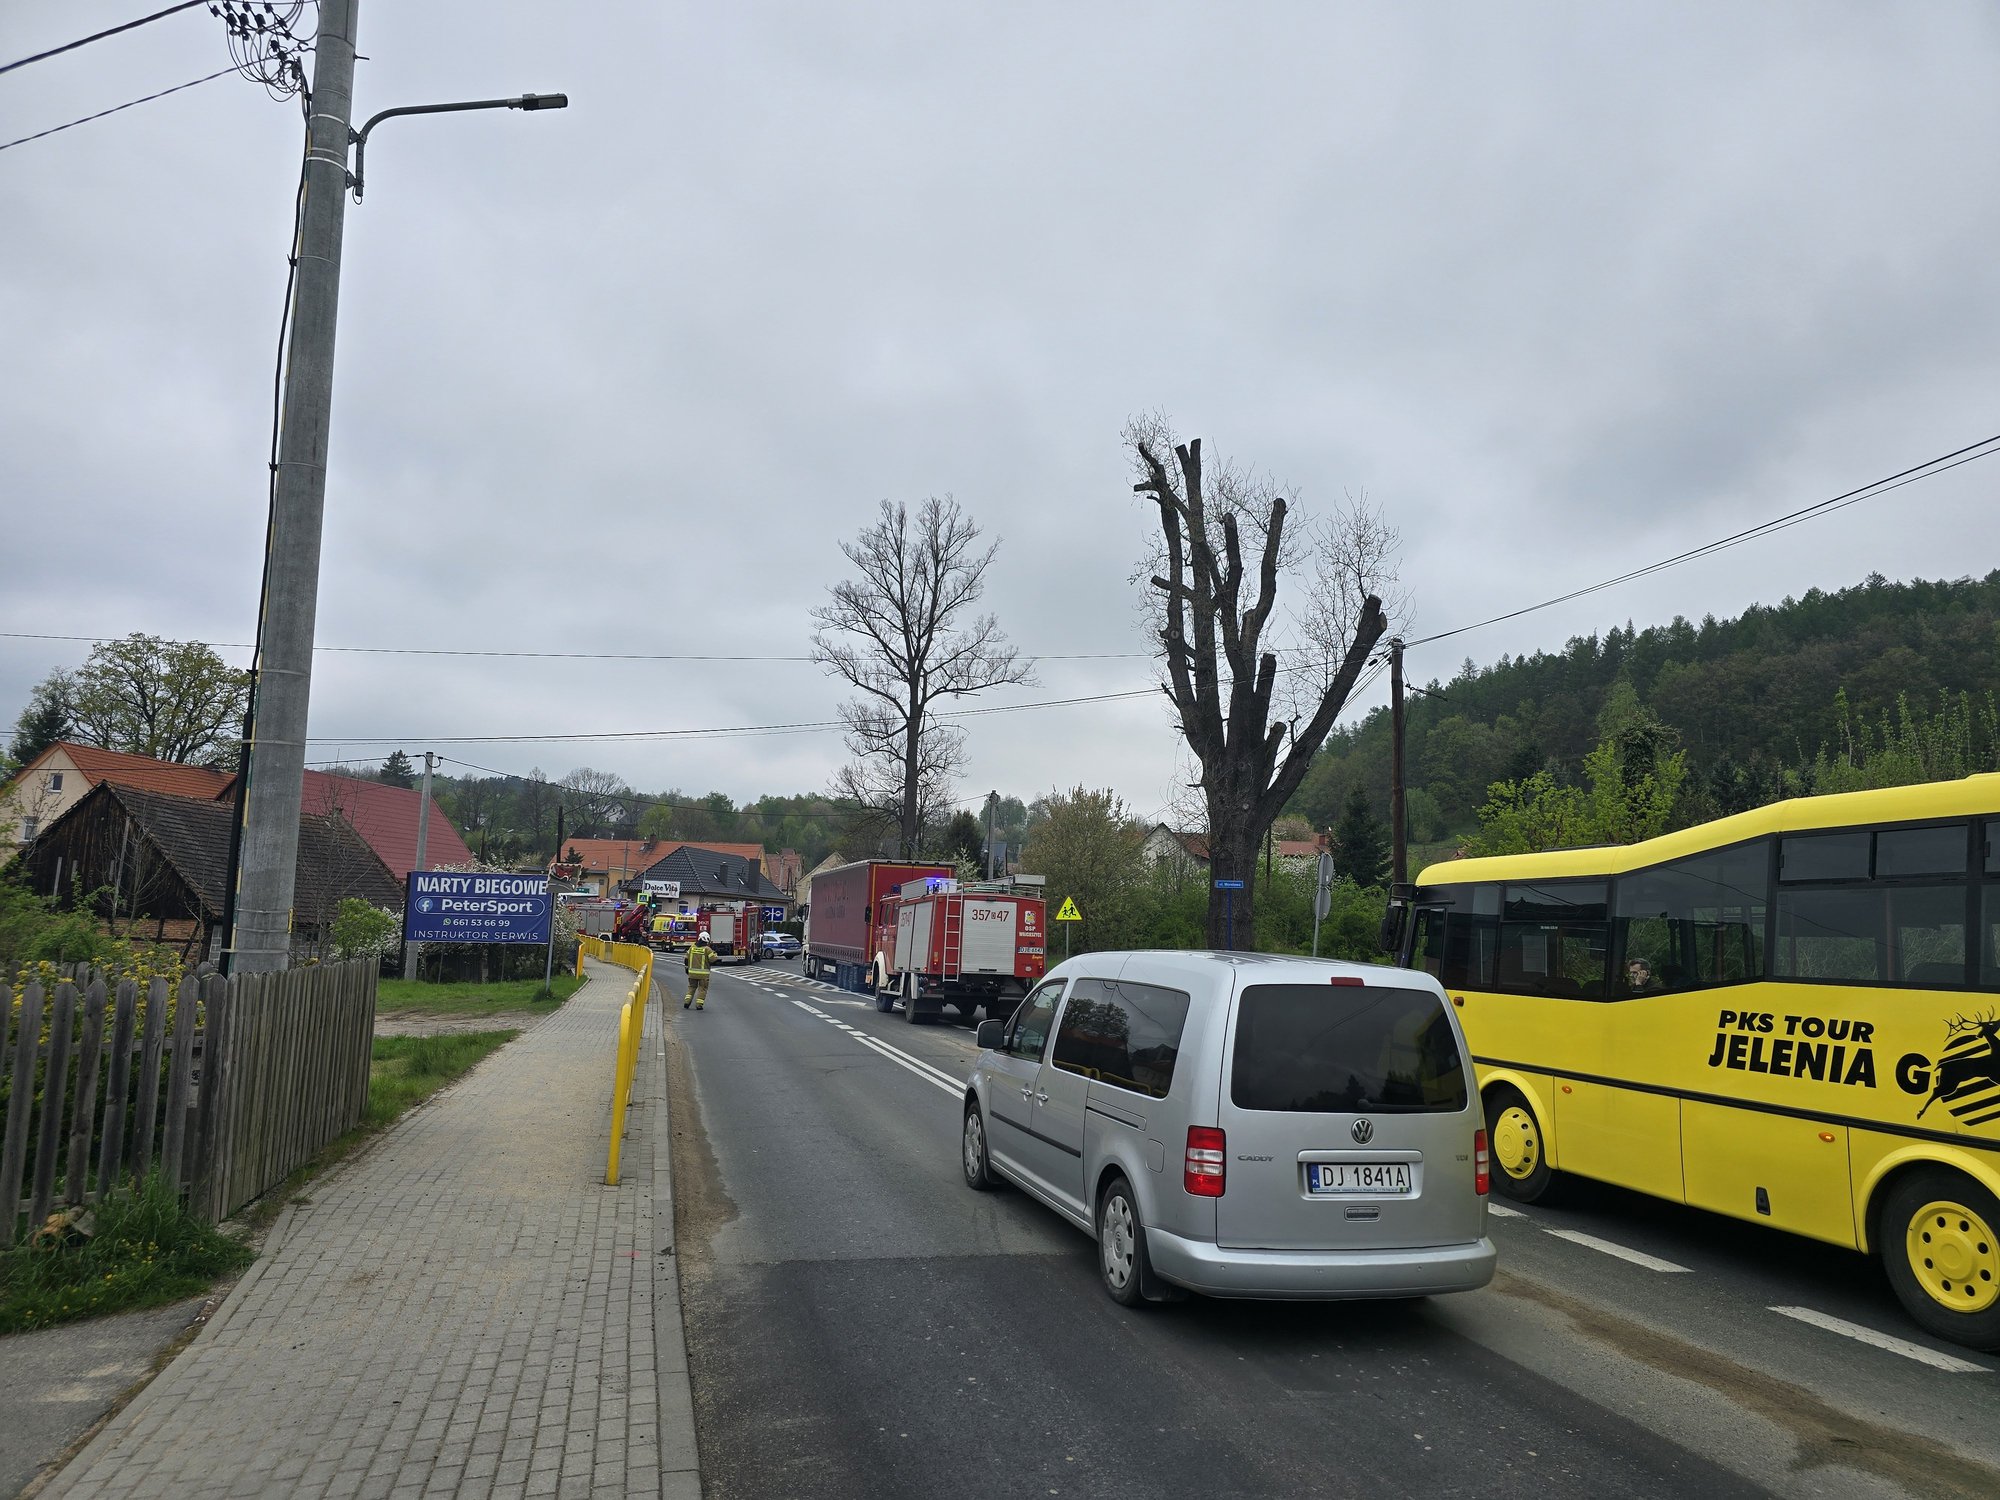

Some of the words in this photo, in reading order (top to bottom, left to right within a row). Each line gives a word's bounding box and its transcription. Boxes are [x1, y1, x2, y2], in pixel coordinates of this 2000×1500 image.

[417, 877, 472, 893] NARTY
[474, 878, 547, 895] BIEGOWE
[645, 883, 663, 891] Dolce
[664, 883, 678, 892] Vita
[441, 899, 532, 914] PeterSport
[484, 919, 496, 927] 66
[414, 930, 489, 940] INSTRUKTOR
[494, 932, 539, 941] SERWIS
[1718, 1010, 1774, 1033] PKS
[1784, 1015, 1874, 1043] TOUR
[1708, 1033, 1877, 1088] JELENIA
[1237, 1154, 1275, 1162] CADDY
[1322, 1167, 1344, 1186] DJ
[1353, 1166, 1406, 1187] 1841A
